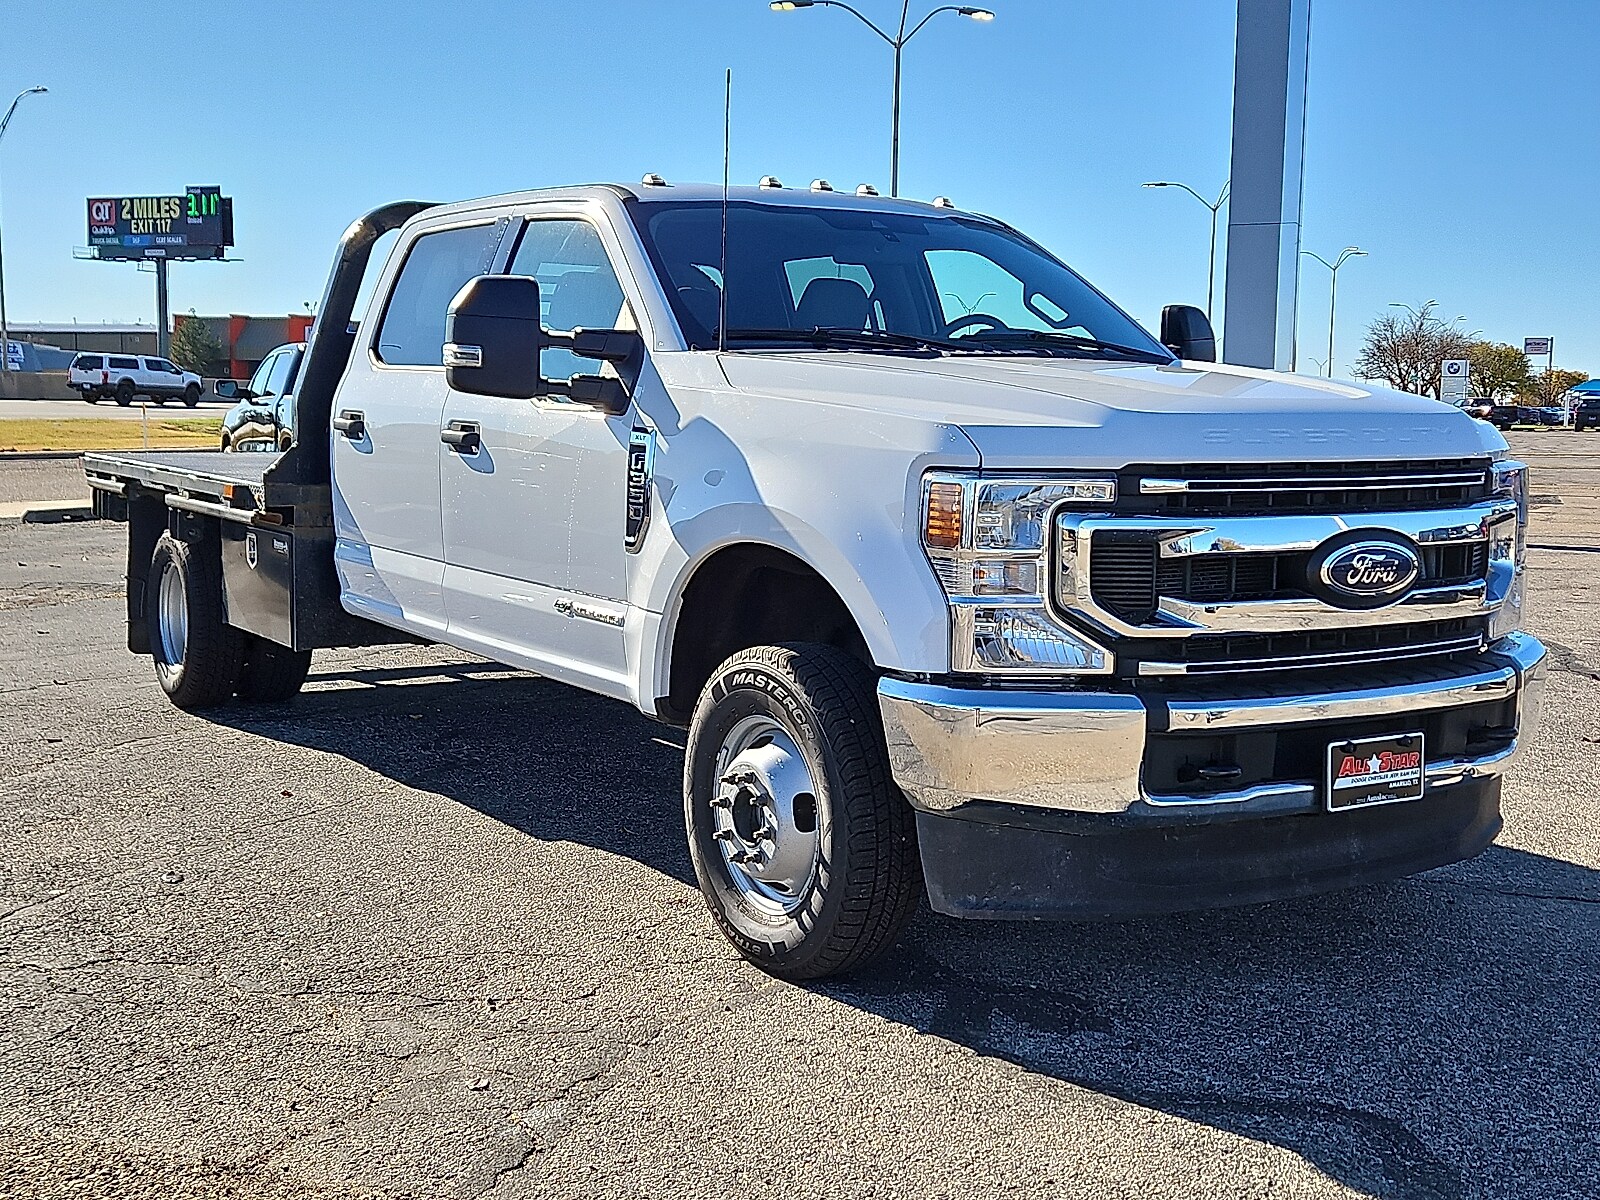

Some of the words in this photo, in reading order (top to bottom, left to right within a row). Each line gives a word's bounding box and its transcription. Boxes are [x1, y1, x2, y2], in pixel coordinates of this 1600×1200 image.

[91, 201, 111, 221] QT
[122, 198, 131, 220] 2
[133, 197, 180, 219] MILES
[131, 219, 154, 234] EXIT
[156, 219, 171, 234] 117
[1203, 428, 1355, 445] SUPER
[1346, 553, 1399, 585] Ford
[1338, 756, 1371, 777] ALL
[1379, 751, 1420, 772] STAR
